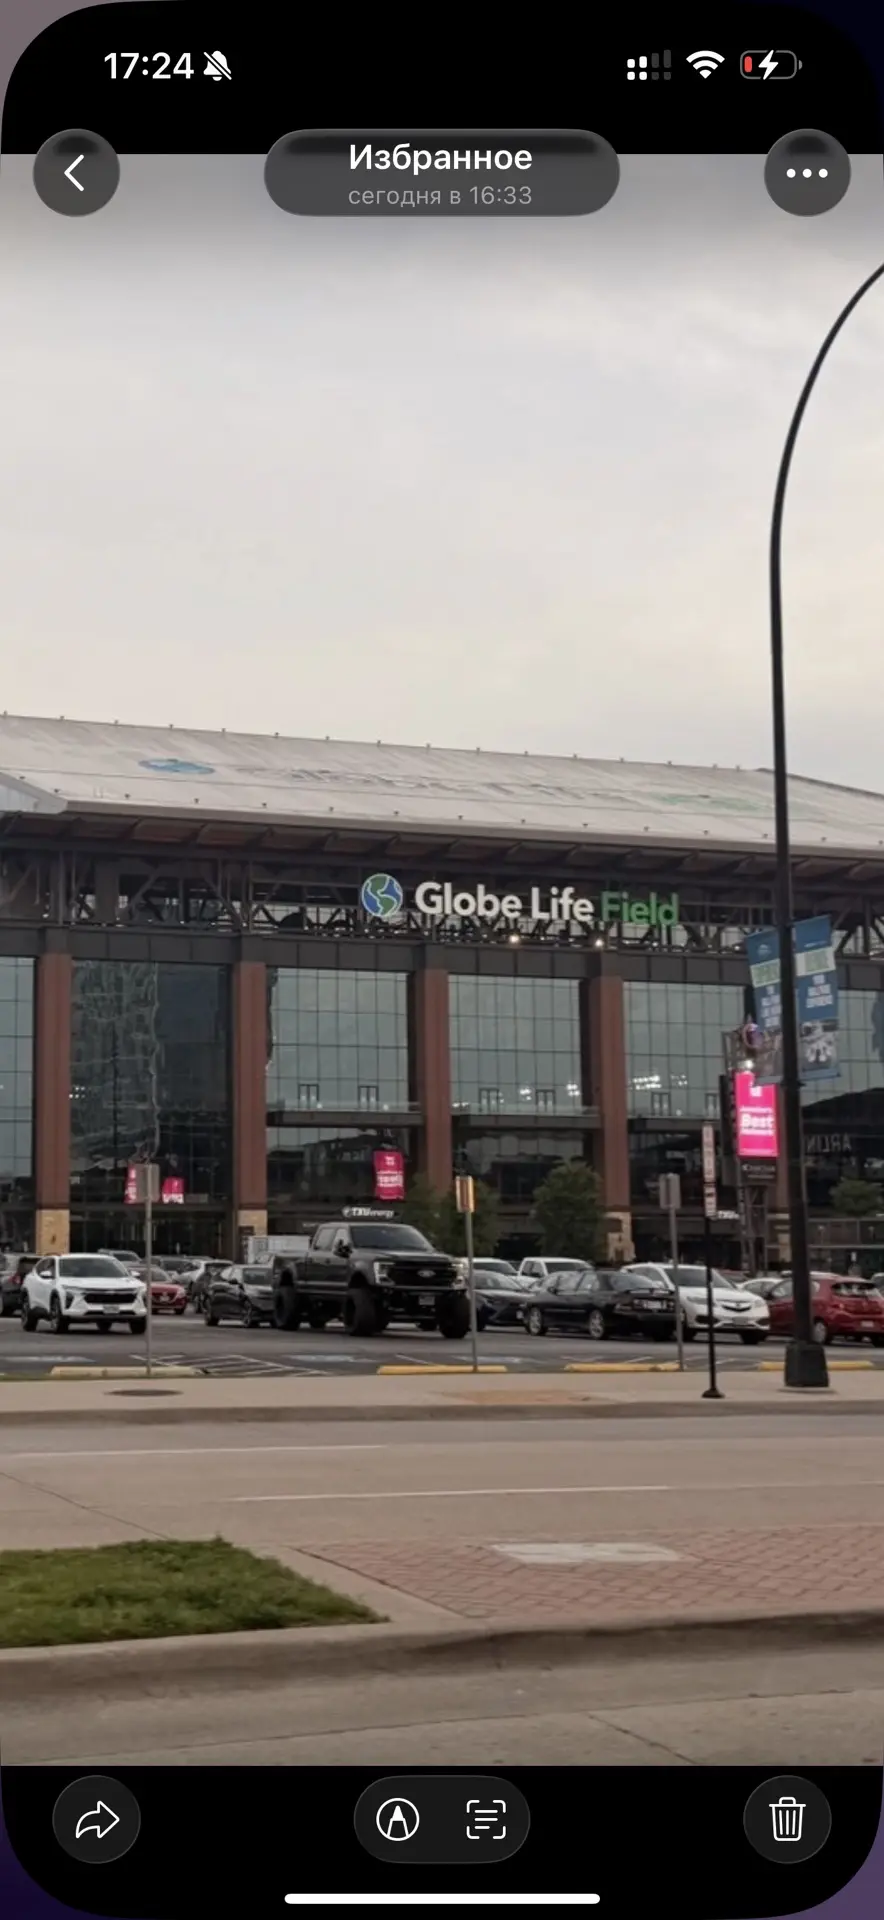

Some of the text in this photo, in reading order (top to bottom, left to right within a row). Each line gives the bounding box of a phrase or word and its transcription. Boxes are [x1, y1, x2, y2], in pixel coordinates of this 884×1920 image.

[415, 881, 679, 927] Globe Life Field
